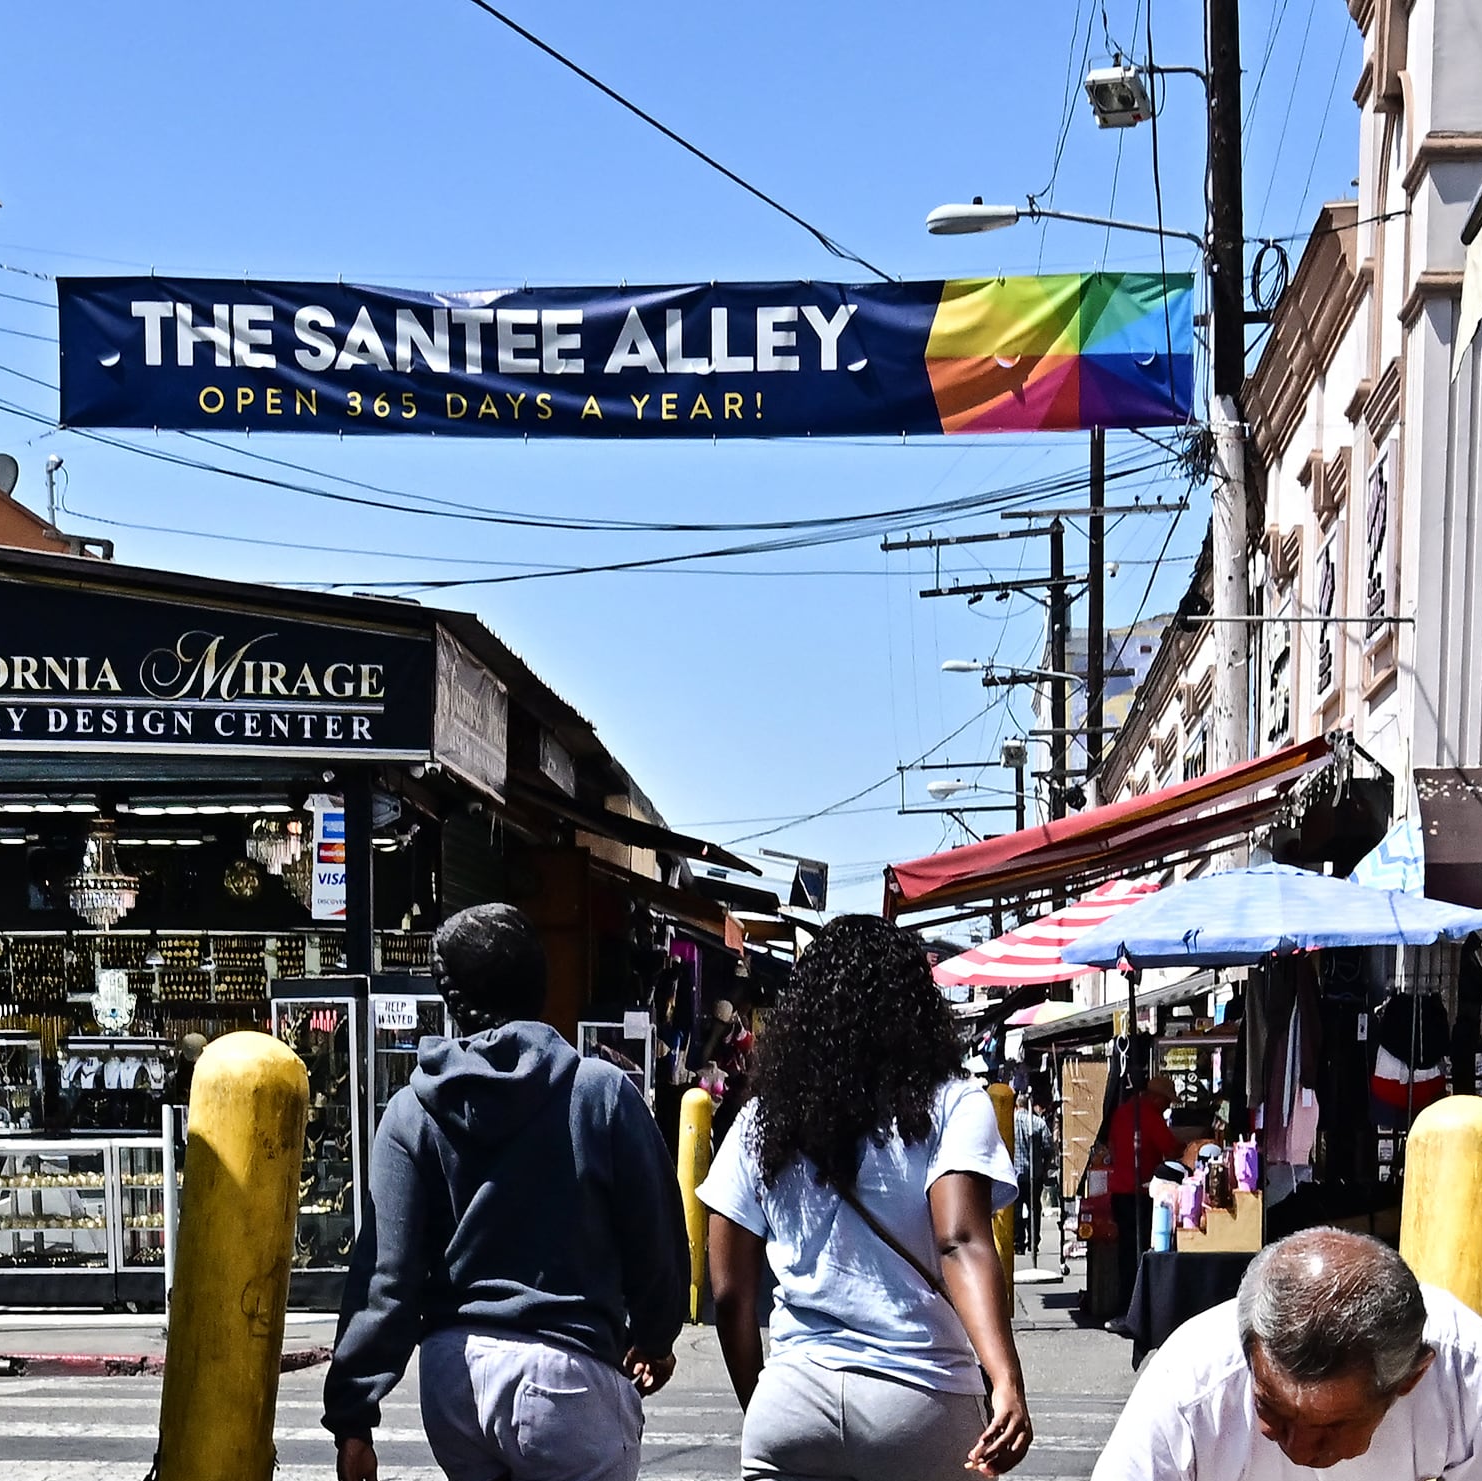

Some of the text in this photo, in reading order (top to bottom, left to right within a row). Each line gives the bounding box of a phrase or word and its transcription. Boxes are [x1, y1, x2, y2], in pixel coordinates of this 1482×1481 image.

[130, 300, 859, 375] THE SANTEE ALLEY
[198, 385, 763, 420] OPEN 365 DAYS A YEAR!
[139, 629, 386, 701] MIRAGE
[46, 708, 194, 736] DESIGN
[214, 711, 373, 741] CENTER
[378, 1014, 414, 1026] WANTED
[384, 1001, 407, 1013] HELP
